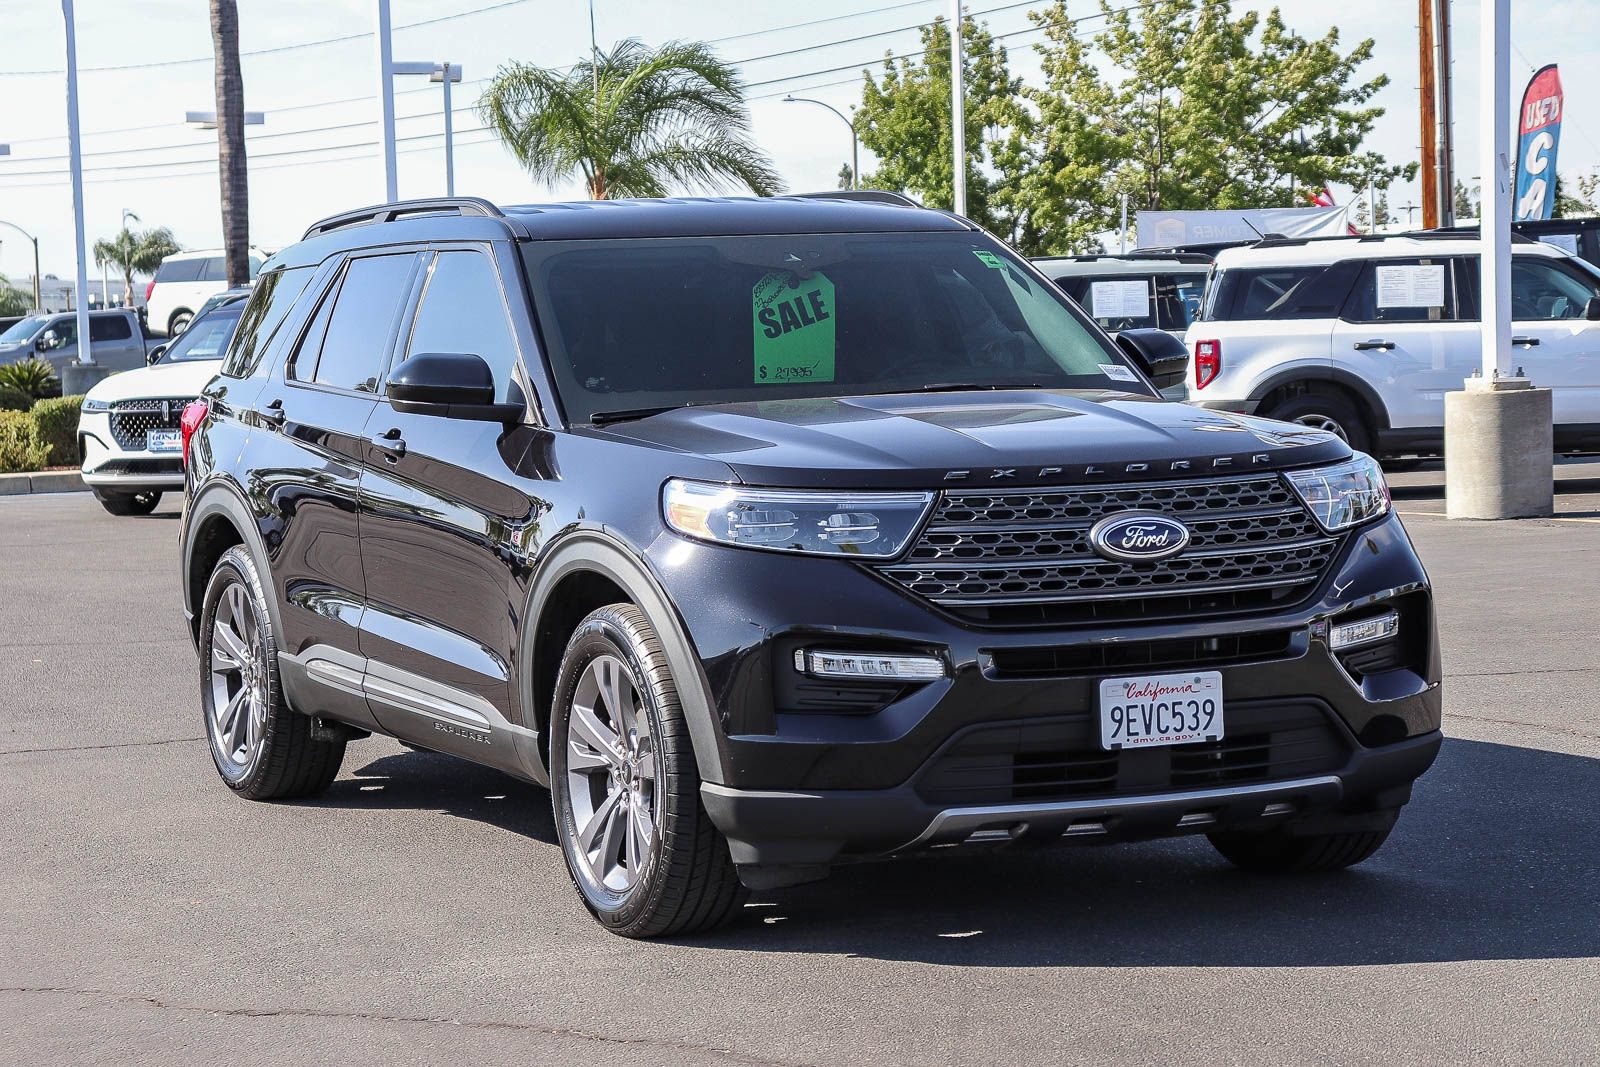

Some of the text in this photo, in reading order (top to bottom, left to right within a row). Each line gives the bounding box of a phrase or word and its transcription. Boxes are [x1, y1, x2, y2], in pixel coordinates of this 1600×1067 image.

[1525, 95, 1560, 130] USED
[758, 289, 830, 339] SALE
[943, 453, 1270, 480] EXPLORER
[1121, 525, 1169, 549] Ford
[1126, 681, 1200, 701] California
[1110, 698, 1215, 738] 9EVC539
[433, 722, 491, 745] EXPLORER
[1133, 734, 1194, 744] dmv.ca.gov
